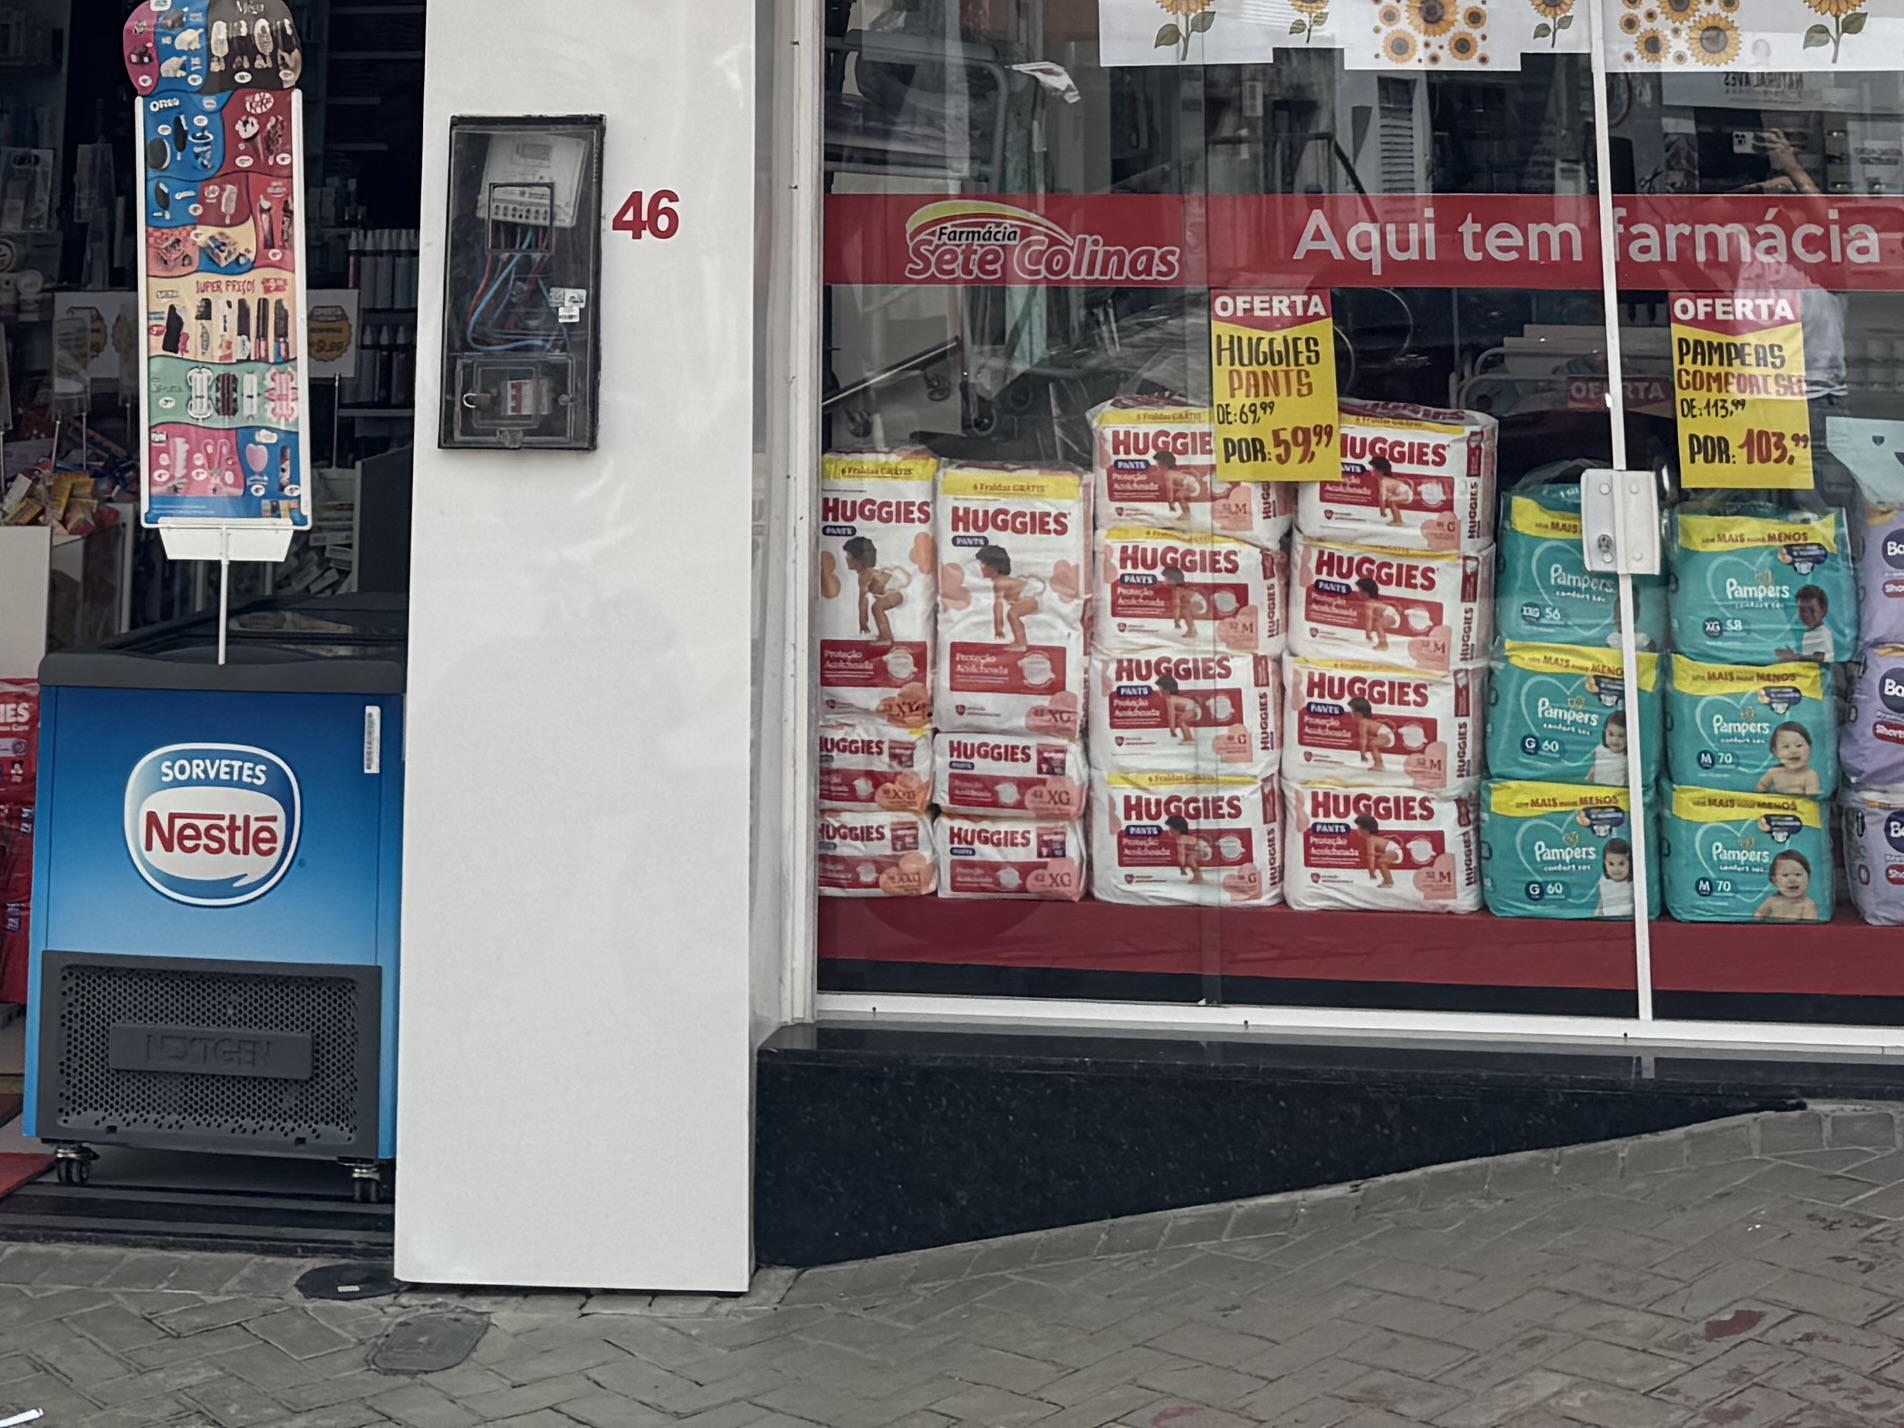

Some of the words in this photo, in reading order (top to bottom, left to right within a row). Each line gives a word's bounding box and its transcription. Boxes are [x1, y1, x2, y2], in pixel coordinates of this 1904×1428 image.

[612, 189, 680, 240] 46
[937, 226, 1018, 241] Farmácia
[1293, 207, 1436, 276] Aqui
[1458, 212, 1583, 262] tem
[1615, 207, 1881, 264] farmácia
[905, 239, 1003, 279] Sete
[1014, 235, 1180, 281] Colinas
[1215, 295, 1326, 317] OFERTA
[1674, 298, 1795, 321] OFERTA
[1216, 334, 1320, 367] HUGGIES
[1228, 369, 1314, 398] PANTS
[1112, 430, 1216, 456] HUGGIE
[822, 497, 931, 524] HUGGIES
[951, 506, 1068, 536] HUGGIES
[1551, 521, 1578, 534] MAIS
[1550, 564, 1616, 594] Pampers
[1726, 578, 1790, 599] Pampers
[1545, 607, 1561, 620] 56
[1726, 620, 1743, 631] 58
[1538, 697, 1598, 726] Pampers
[1713, 714, 1770, 735] Pampers
[1542, 742, 1559, 752] 60
[1718, 753, 1733, 764] 70
[161, 759, 267, 785] SORVETES
[1047, 791, 1071, 805] XG
[1579, 795, 1619, 805] MENOS
[1535, 841, 1596, 863] Pampers
[1712, 842, 1769, 863] Pampers
[1049, 873, 1072, 887] XG
[1547, 882, 1563, 894] 60
[1716, 881, 1731, 891] 70
